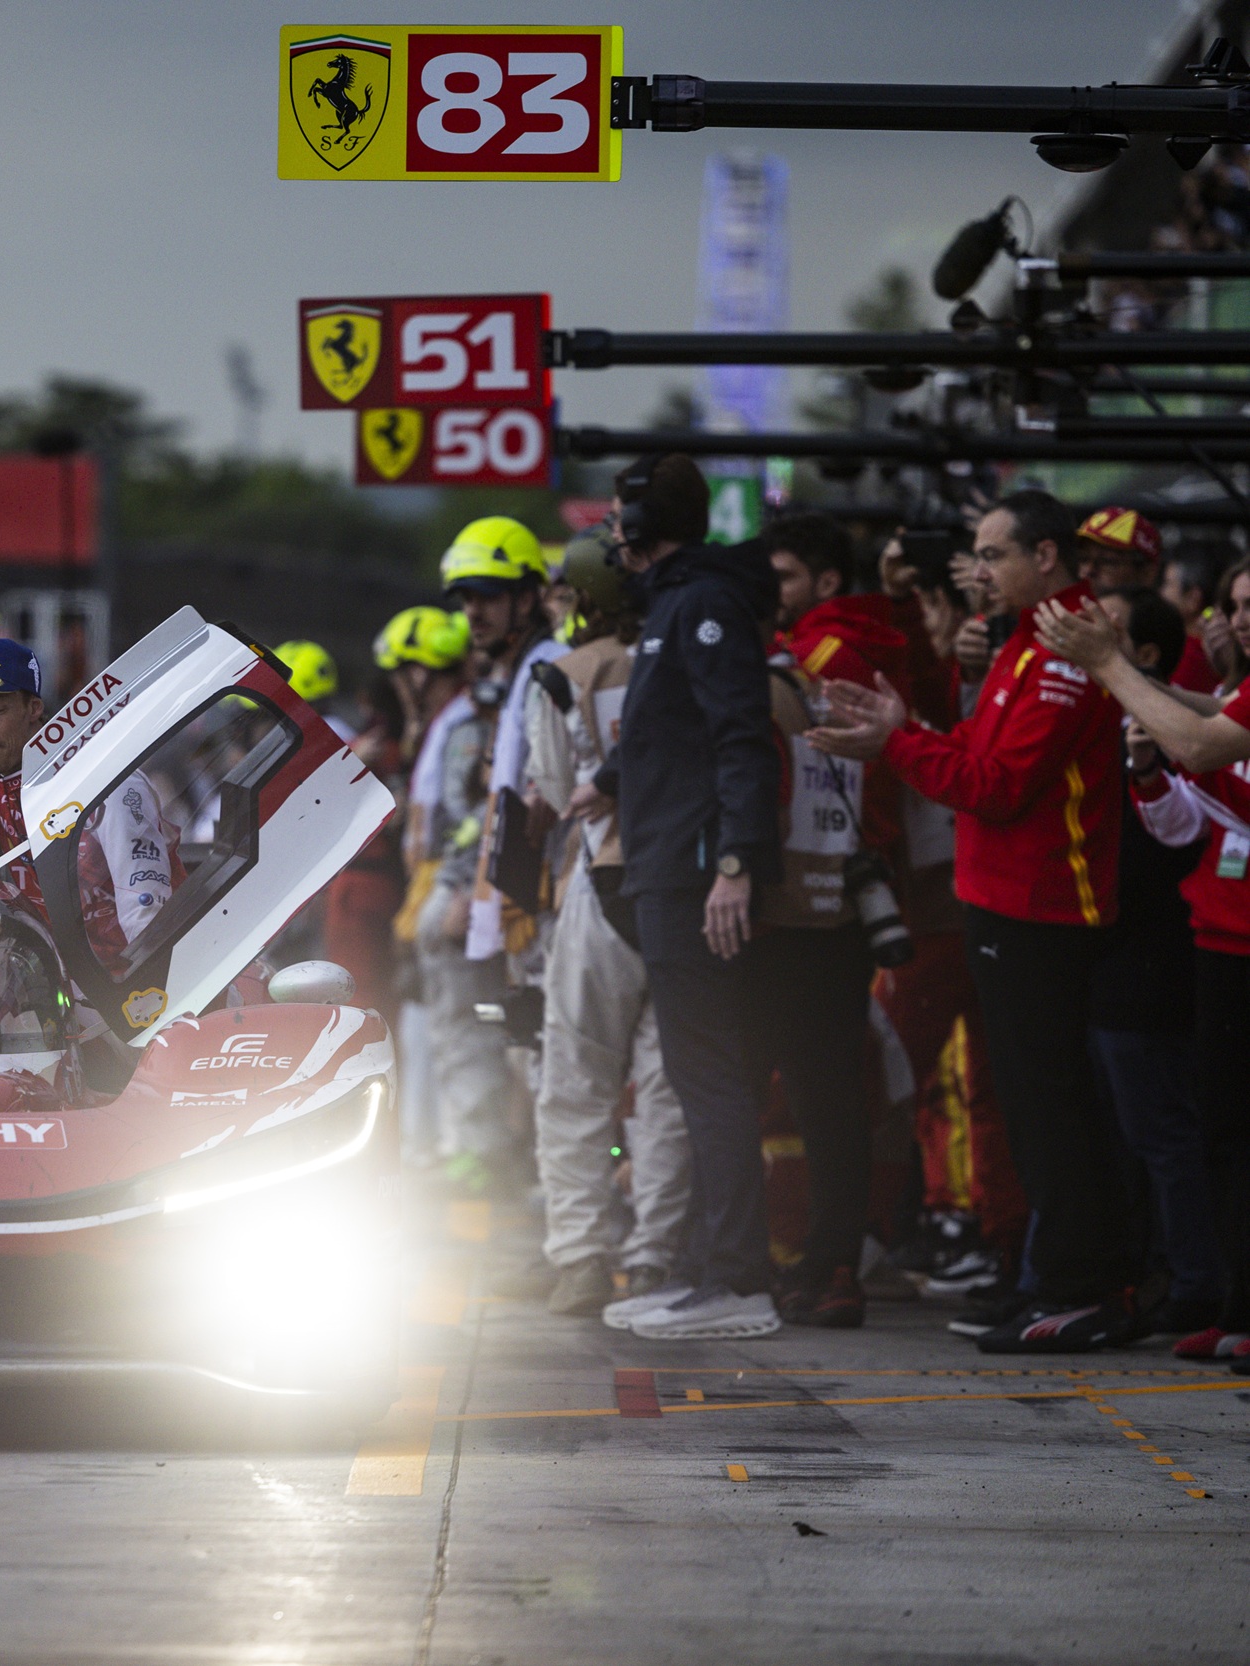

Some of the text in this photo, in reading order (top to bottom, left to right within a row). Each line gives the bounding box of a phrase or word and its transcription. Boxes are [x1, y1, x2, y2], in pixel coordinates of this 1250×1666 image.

[417, 52, 590, 154] 83
[402, 312, 529, 391] 51
[434, 409, 543, 475] 50
[29, 673, 123, 755] TOYOTA
[190, 1055, 293, 1071] EDIFICE
